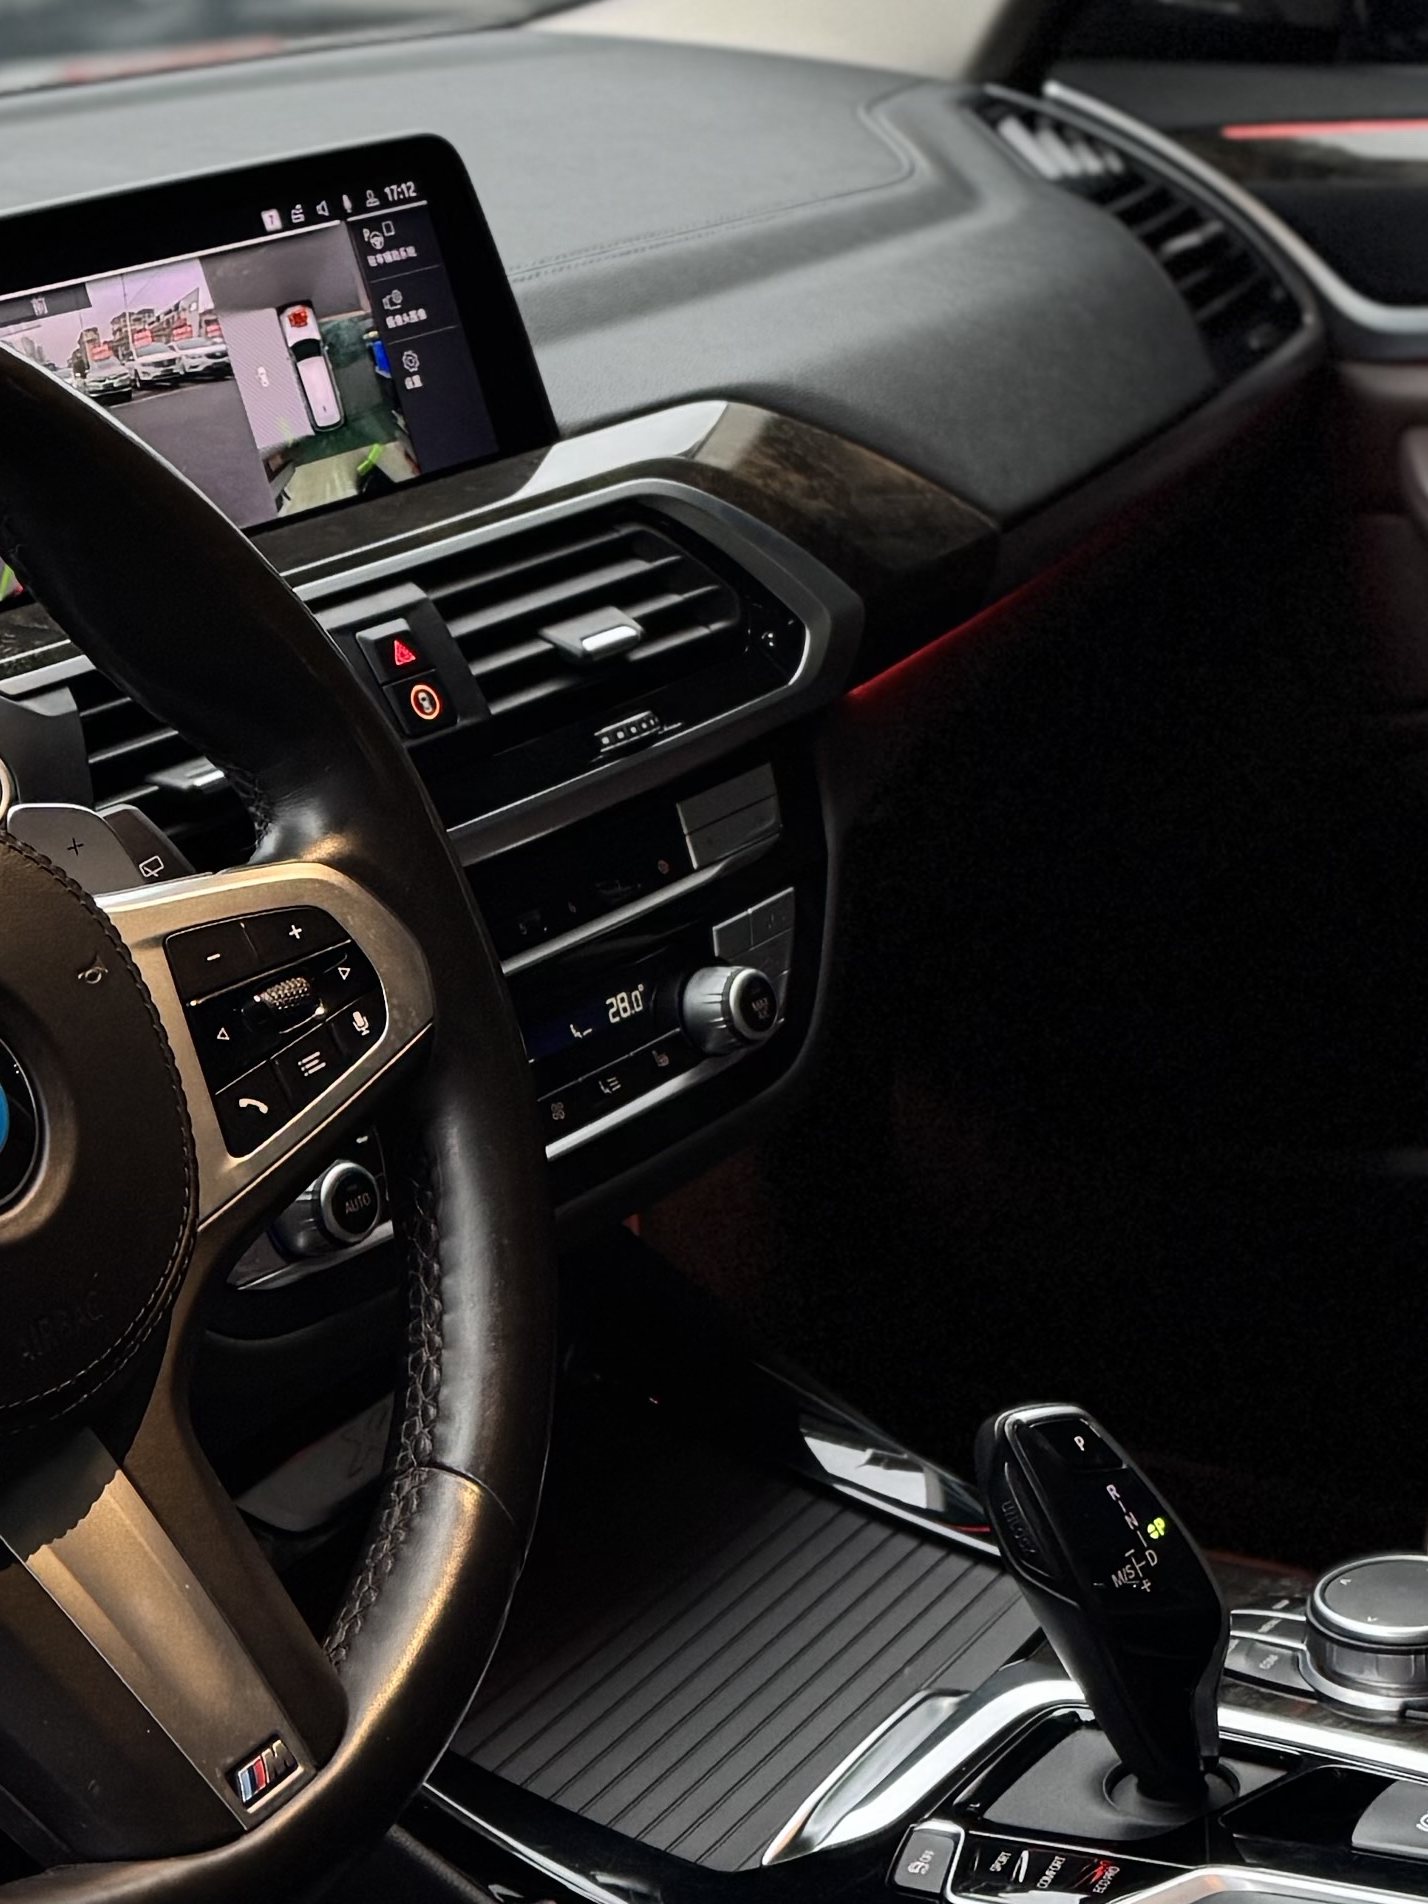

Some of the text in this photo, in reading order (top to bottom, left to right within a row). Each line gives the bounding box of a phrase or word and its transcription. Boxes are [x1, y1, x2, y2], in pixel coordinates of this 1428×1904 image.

[383, 180, 418, 203] 17:12
[345, 1192, 371, 1215] AUTO
[1073, 1435, 1085, 1452] P
[1106, 1483, 1120, 1500] R
[1124, 1511, 1139, 1530] N
[1145, 1549, 1159, 1567] D
[990, 1851, 1012, 1872] SPORT
[1036, 1855, 1067, 1889] COMFORT
